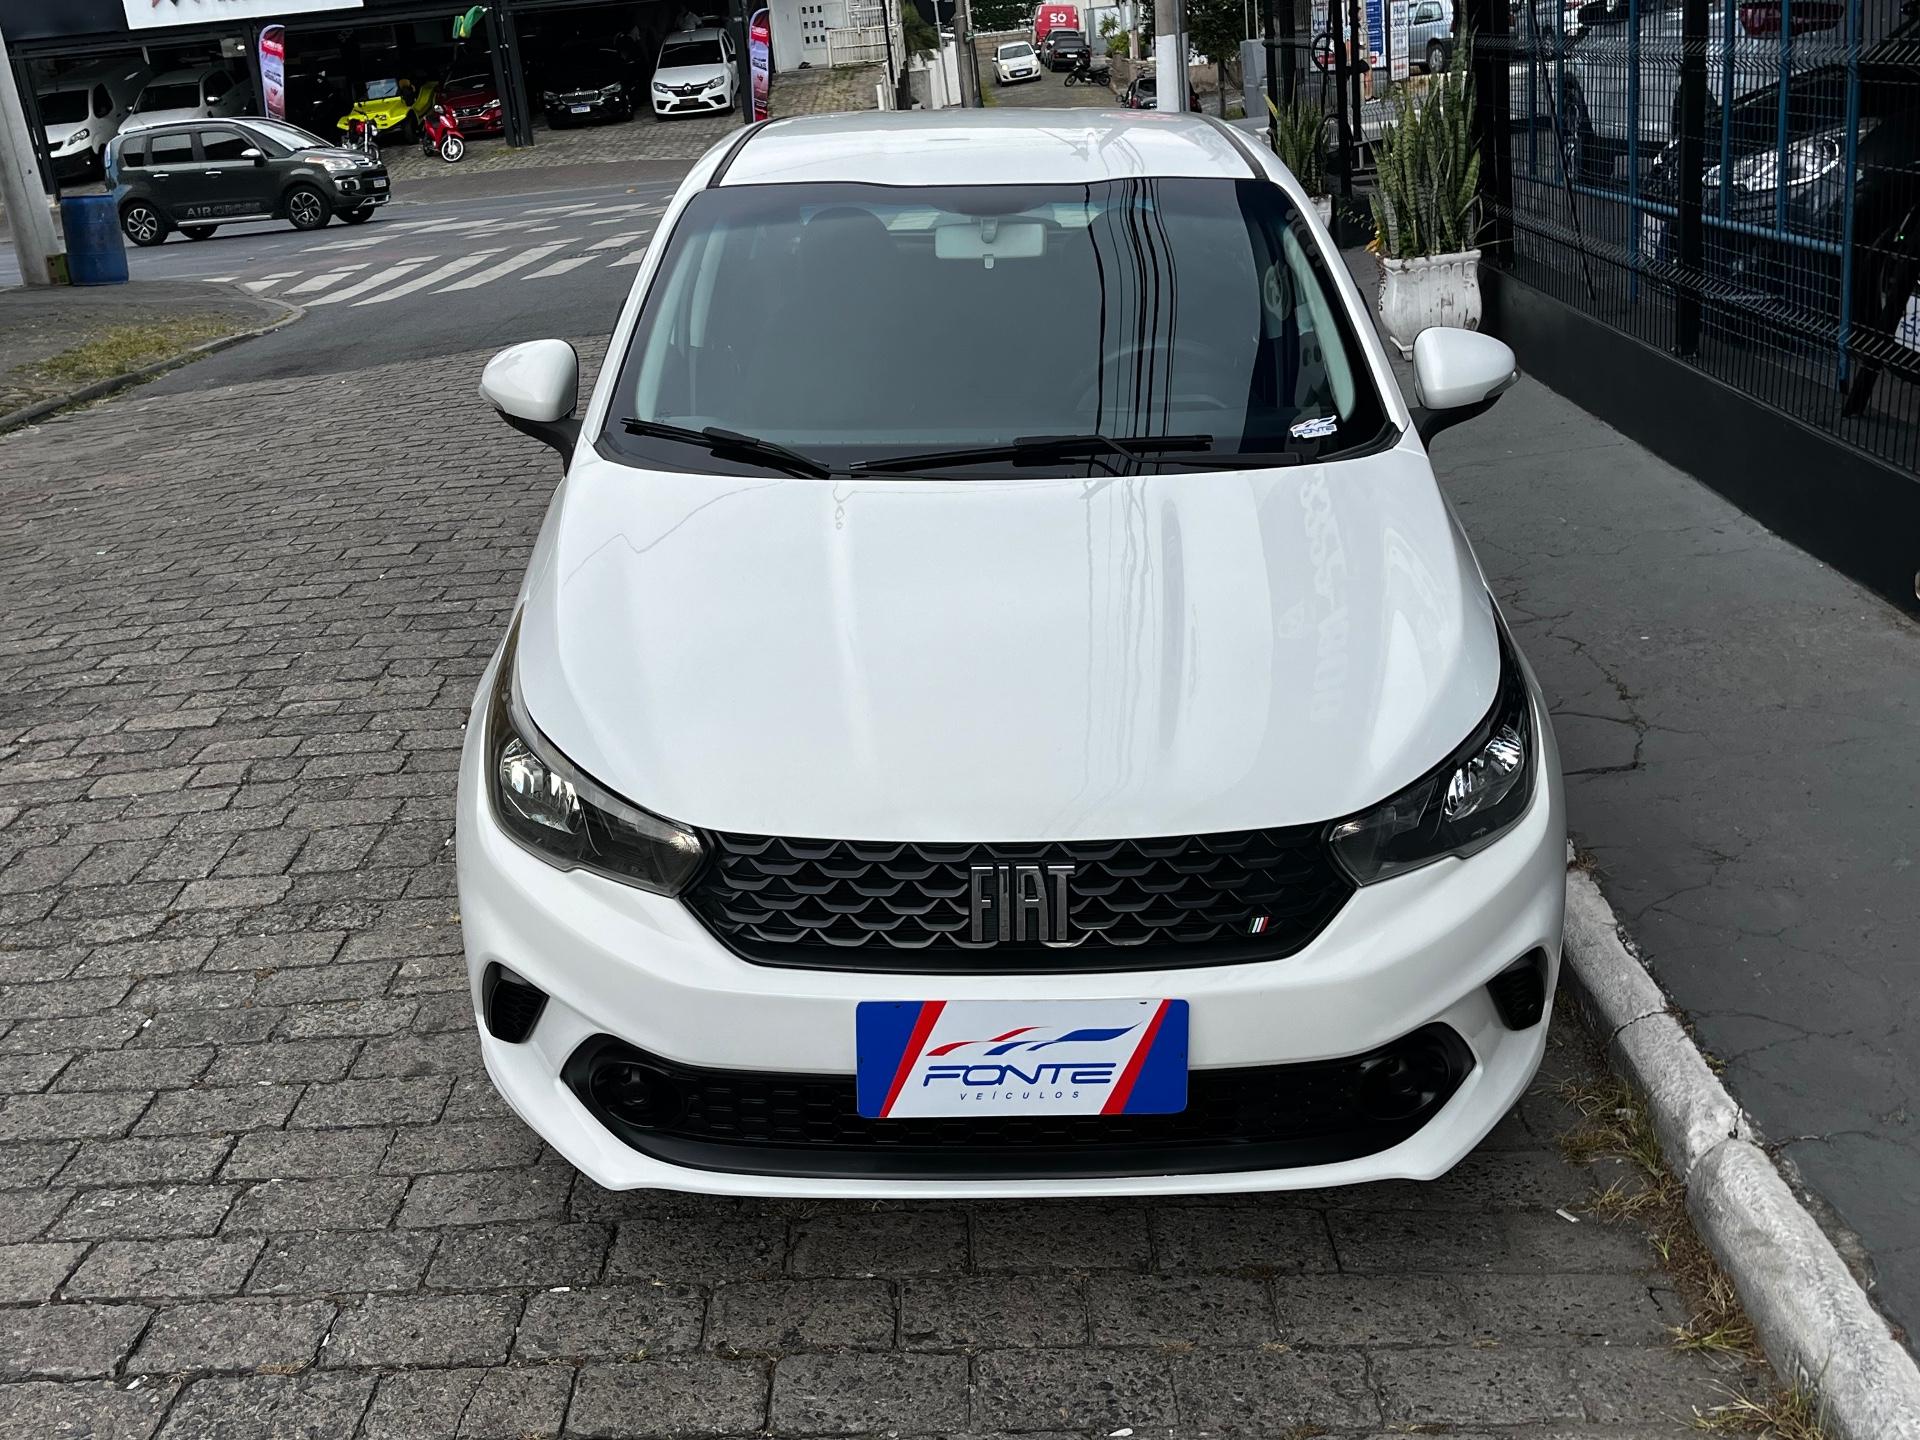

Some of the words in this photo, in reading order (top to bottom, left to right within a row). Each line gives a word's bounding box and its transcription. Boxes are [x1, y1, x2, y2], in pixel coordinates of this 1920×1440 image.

[1294, 424, 1335, 435] FONTE
[970, 865, 1075, 942] FIAT
[923, 1062, 1117, 1088] FONTE
[959, 1090, 1080, 1101] VEÍCULOS
